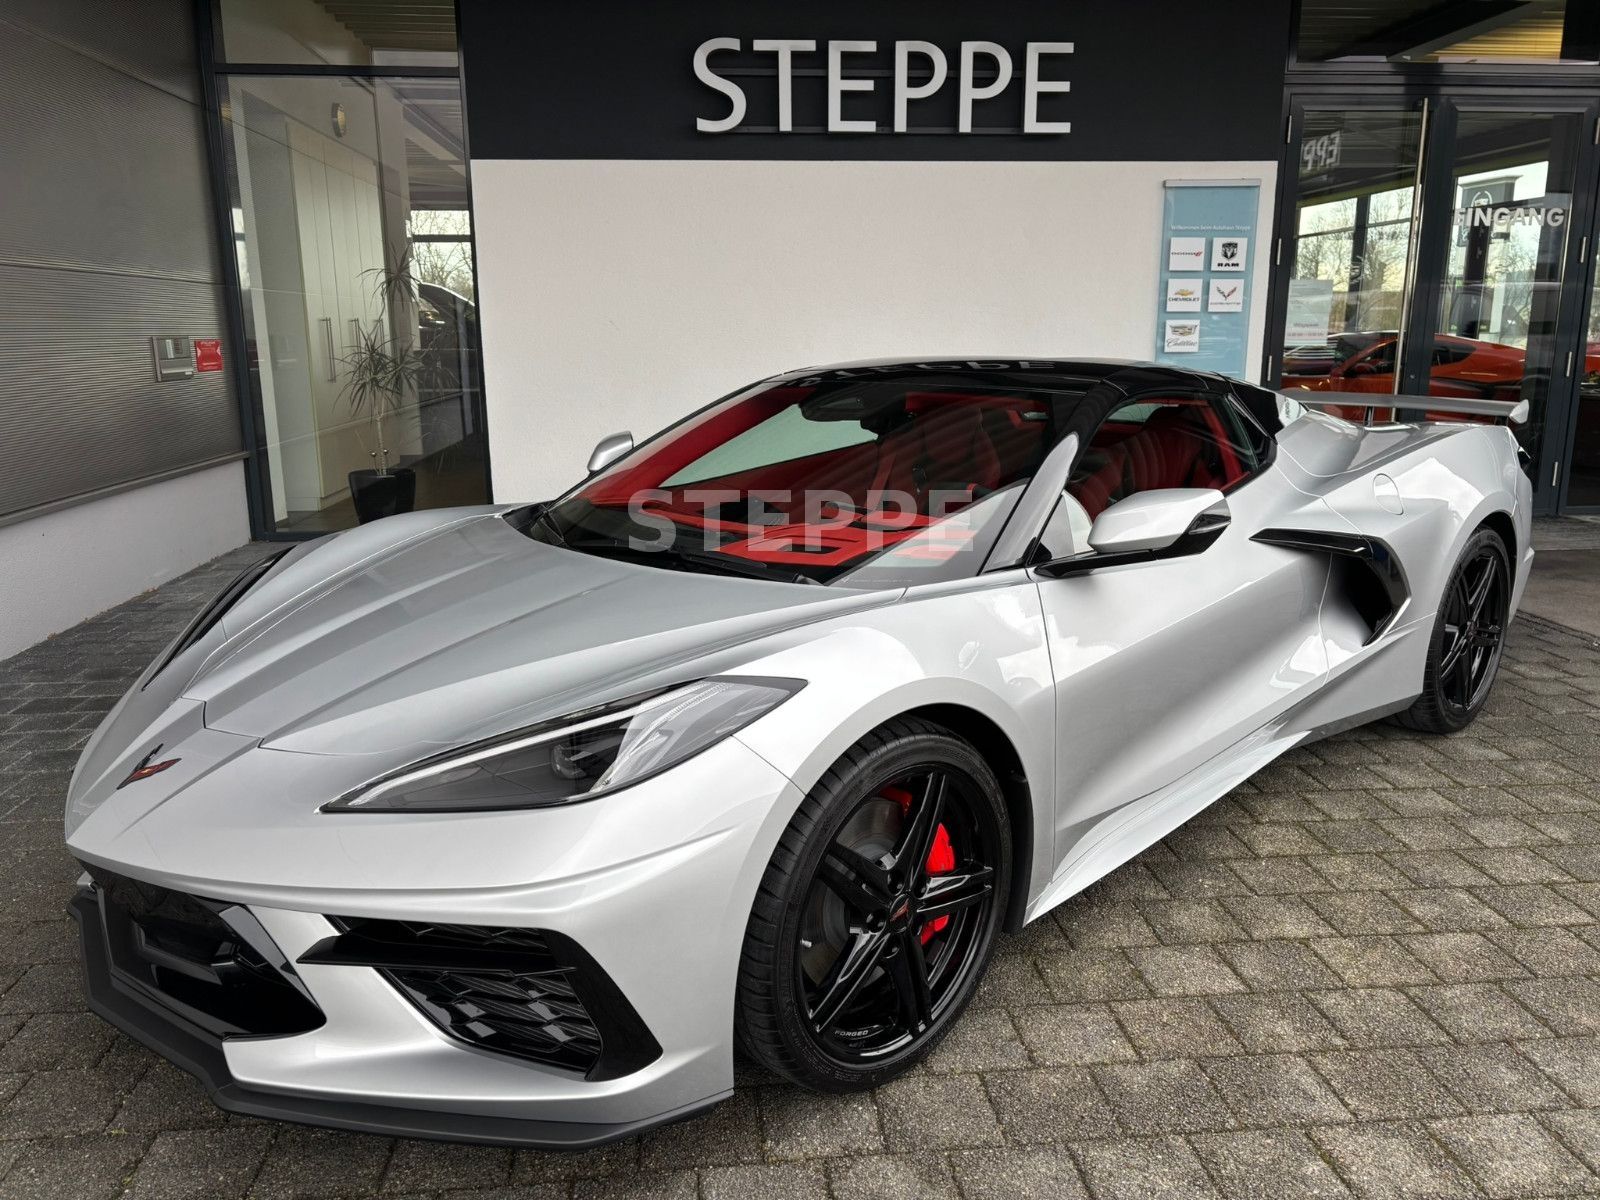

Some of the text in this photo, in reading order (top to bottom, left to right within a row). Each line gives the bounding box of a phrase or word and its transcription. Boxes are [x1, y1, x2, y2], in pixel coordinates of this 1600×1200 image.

[693, 37, 1074, 134] STEPPE
[1453, 207, 1565, 227] EINGANG
[834, 1029, 869, 1037] FORGED
